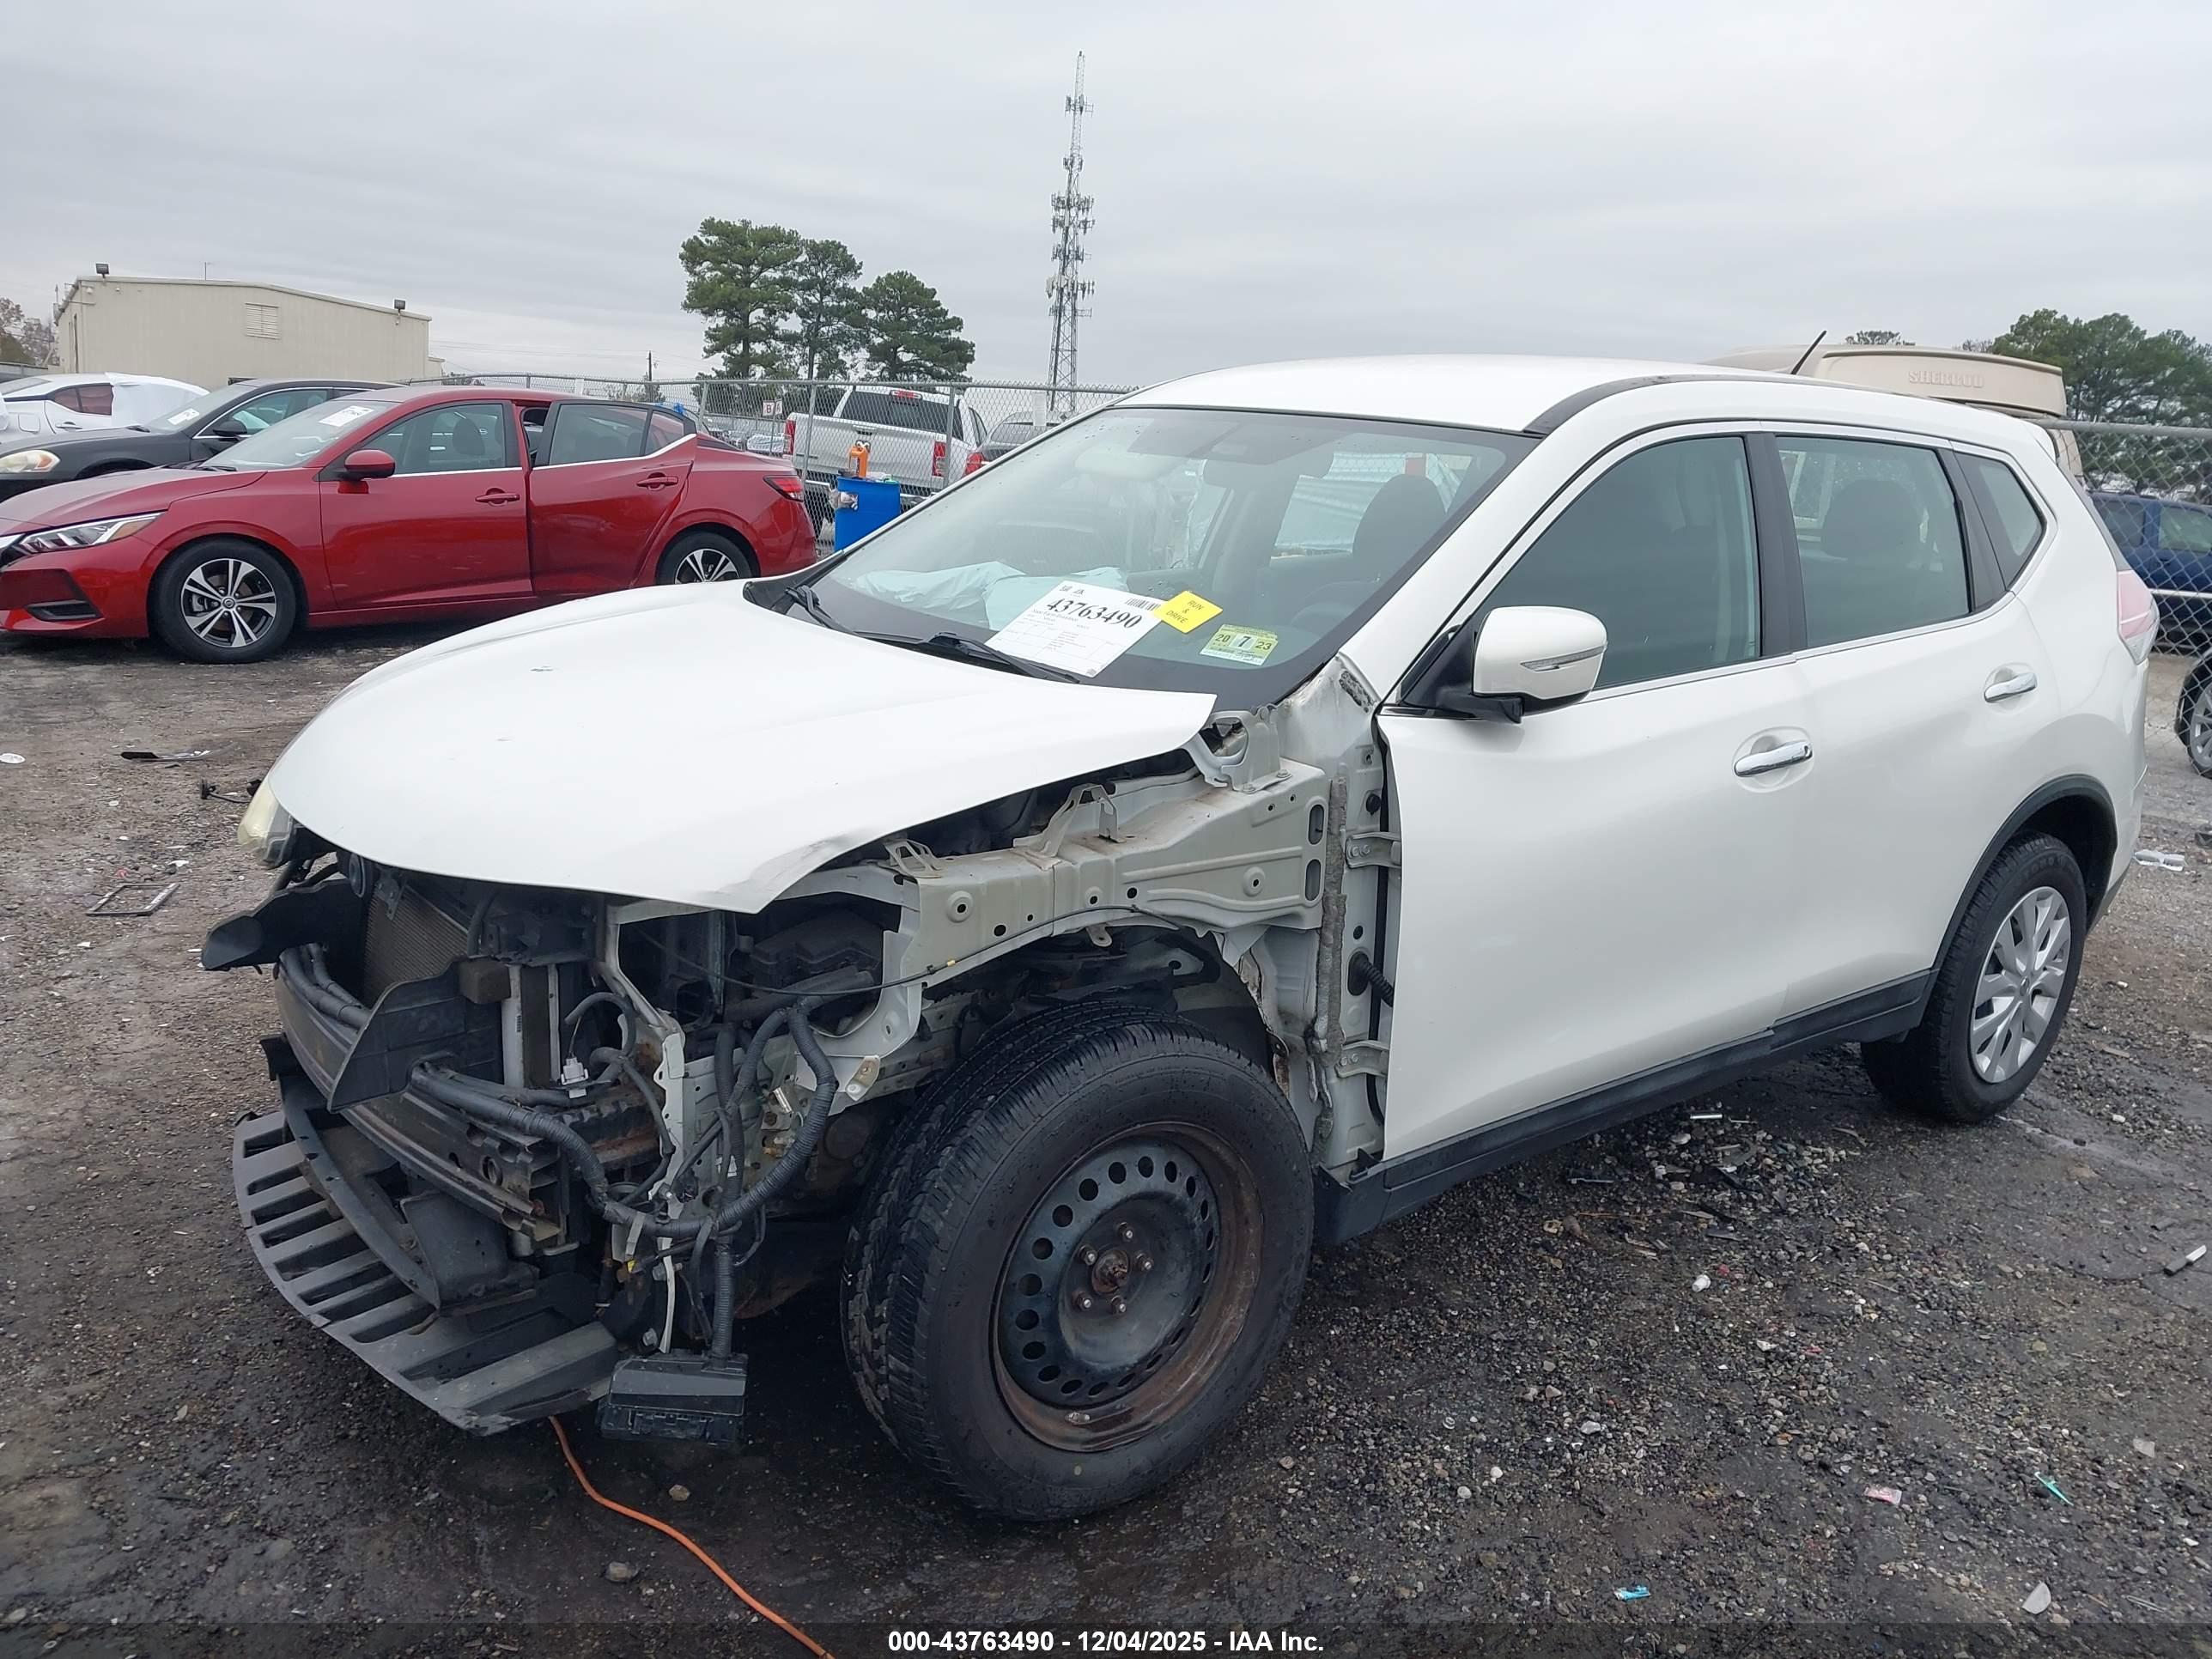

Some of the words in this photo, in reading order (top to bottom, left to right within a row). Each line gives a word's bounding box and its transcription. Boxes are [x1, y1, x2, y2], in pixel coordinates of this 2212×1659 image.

[1187, 599, 1205, 611] RUN
[1046, 598, 1143, 629] 43763490
[1165, 610, 1188, 624] DRIVE
[1215, 634, 1231, 643] 20
[1237, 635, 1251, 647] 7
[1255, 641, 1273, 651] 23
